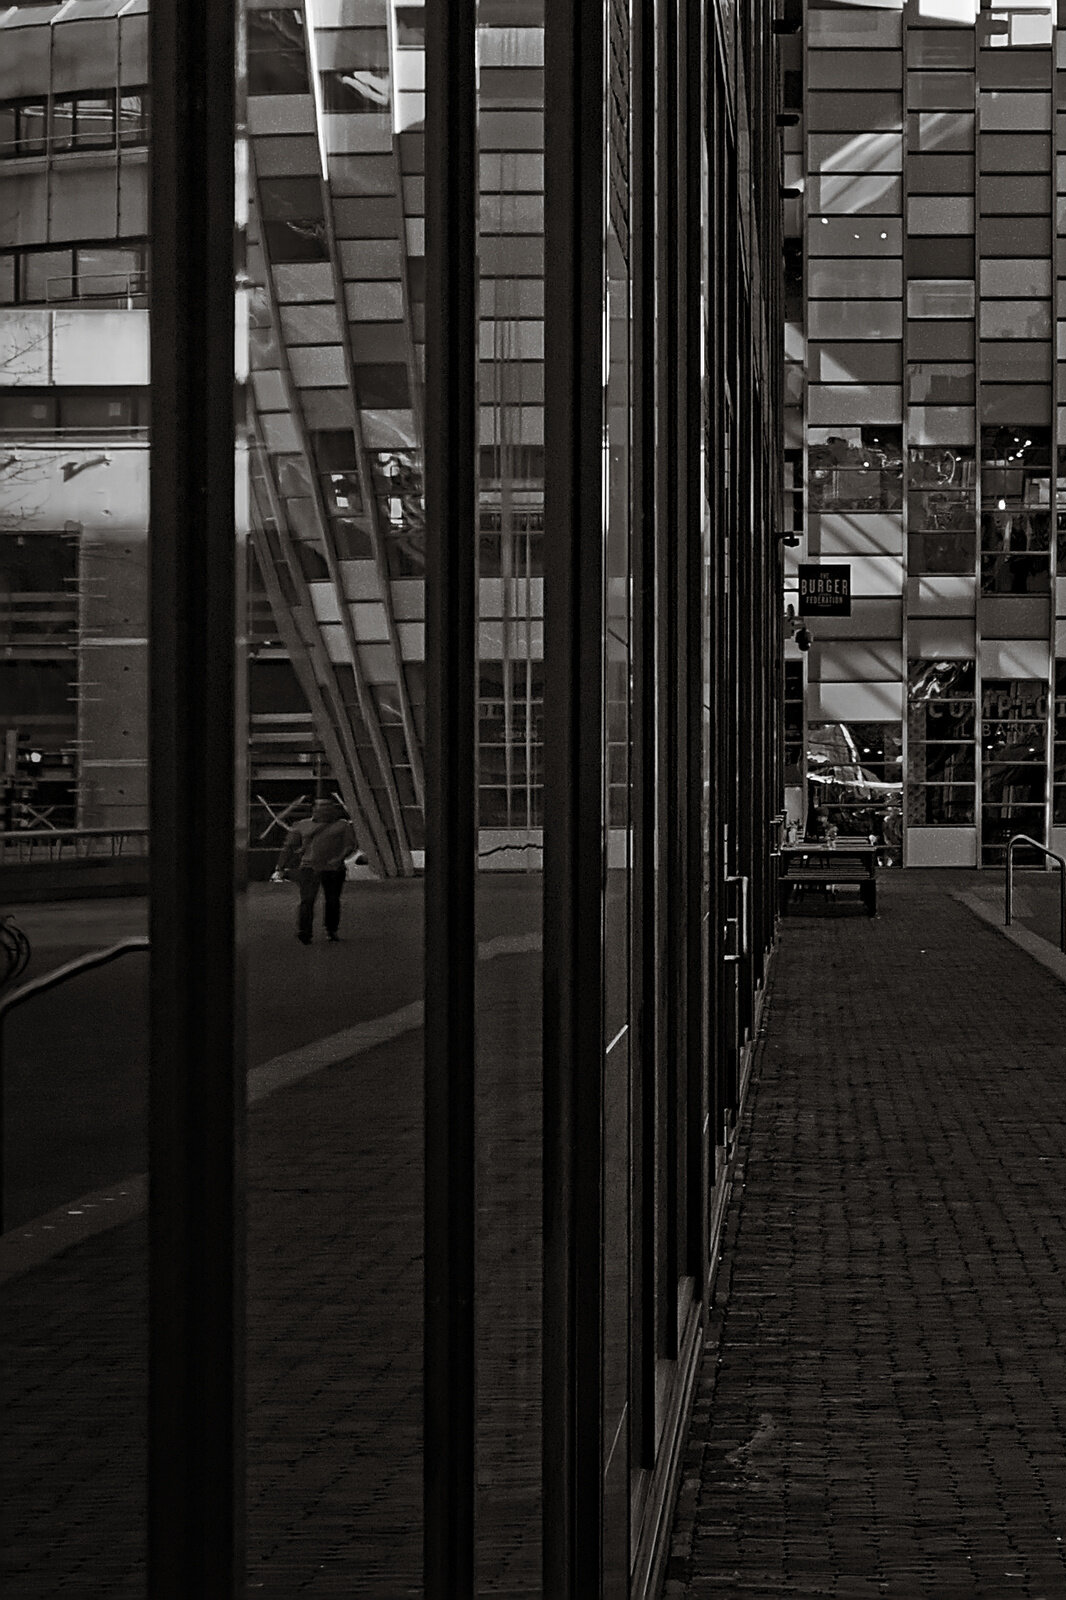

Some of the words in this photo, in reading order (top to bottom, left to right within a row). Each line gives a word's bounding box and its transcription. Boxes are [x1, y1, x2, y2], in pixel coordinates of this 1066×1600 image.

[801, 579, 848, 596] BURGER
[806, 596, 843, 604] FEDERATION
[960, 723, 1060, 738] LBANAI
